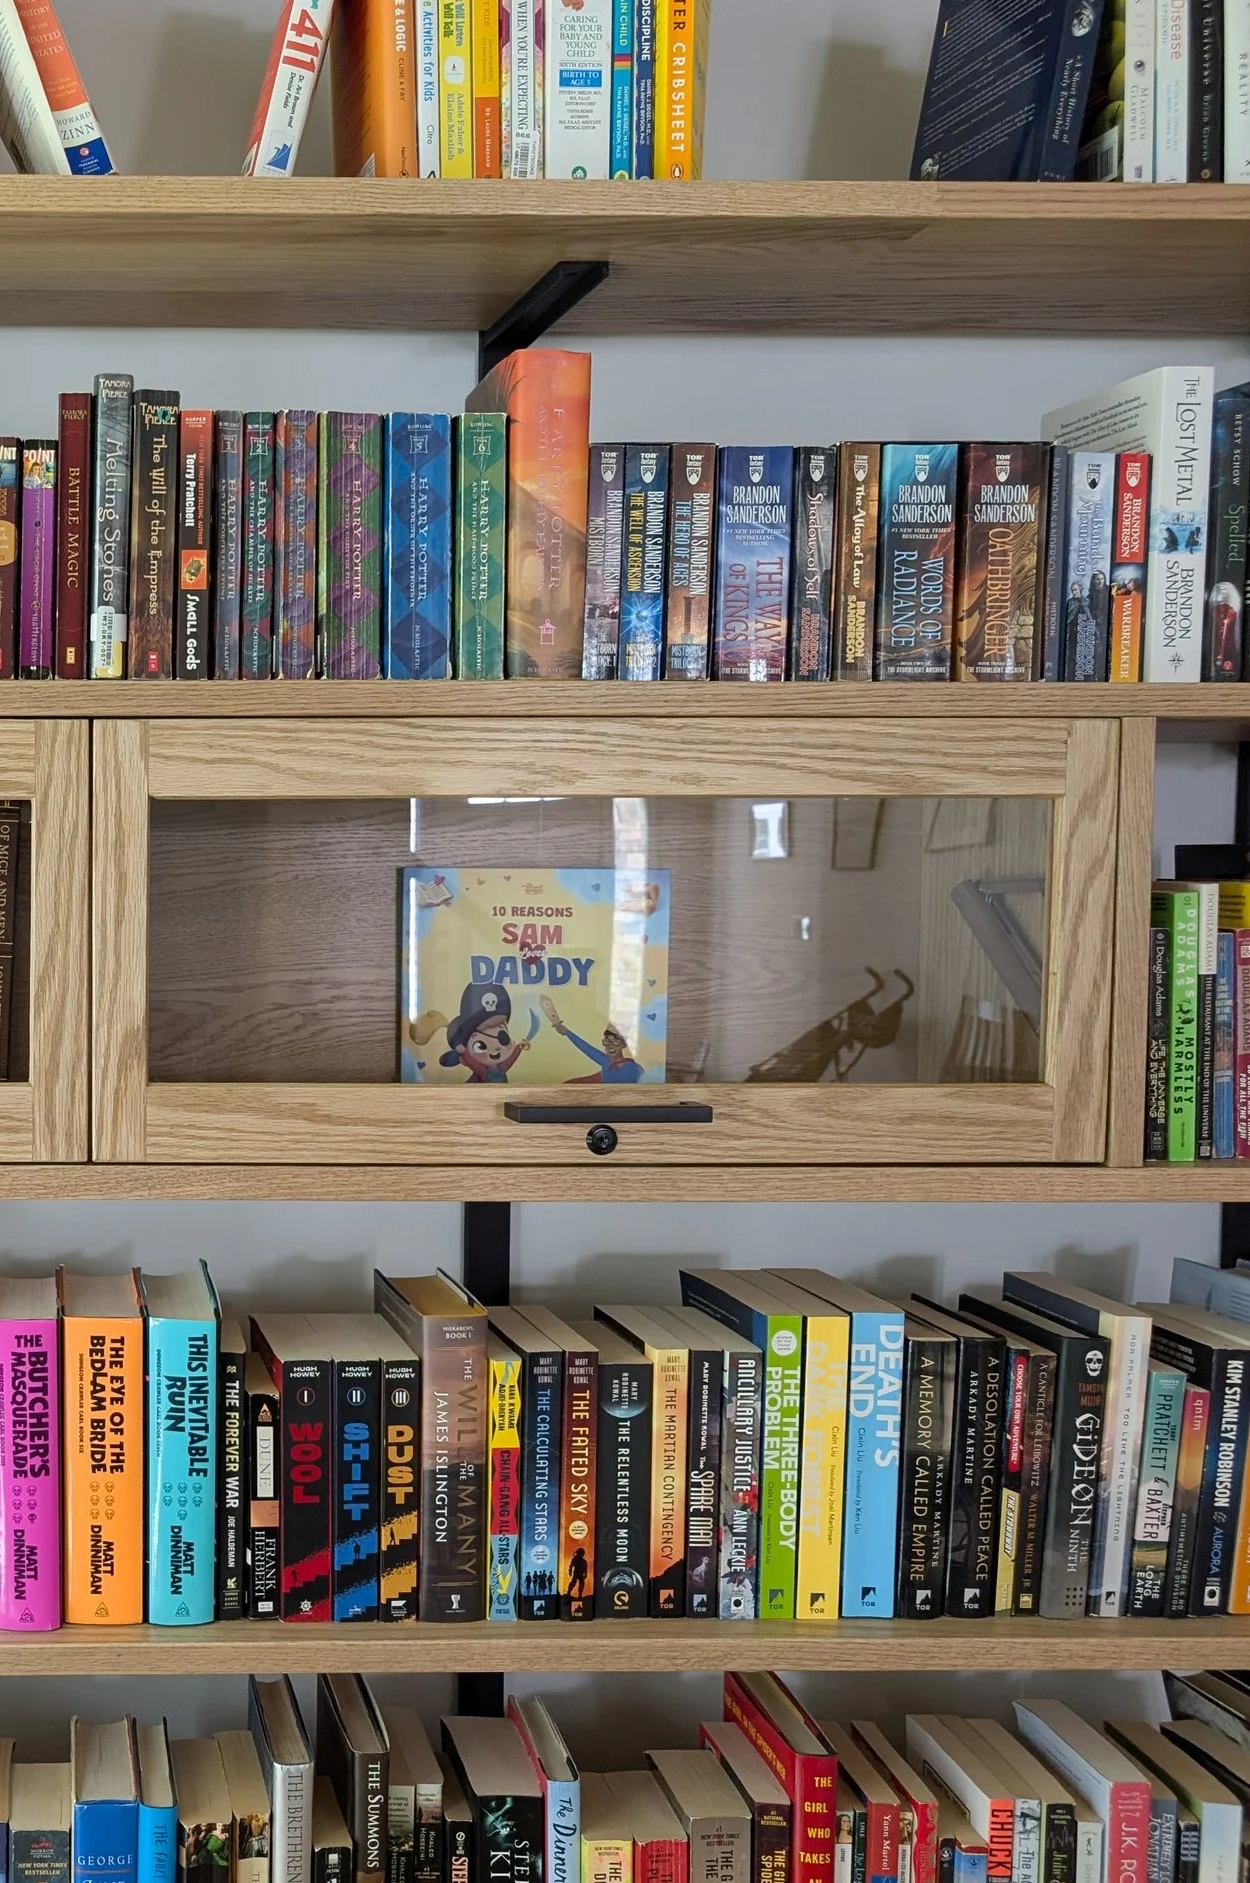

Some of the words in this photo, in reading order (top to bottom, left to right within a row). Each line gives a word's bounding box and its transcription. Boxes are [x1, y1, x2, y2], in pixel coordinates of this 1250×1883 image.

[564, 16, 598, 24] CARING
[282, 9, 324, 74] 411
[670, 43, 685, 152] CRIBSHEET
[56, 111, 91, 127] HOWARD
[62, 122, 95, 141] ZINN
[1183, 376, 1201, 398] THE
[1177, 402, 1201, 442] LOST
[153, 434, 167, 462] The
[98, 438, 123, 522] Melting
[154, 466, 165, 495] Will
[733, 485, 780, 503] BRANDON
[1176, 447, 1199, 506] METAL
[146, 500, 165, 518] of
[418, 476, 429, 538] HARRY
[726, 505, 786, 524] SANDERSON
[151, 522, 165, 545] the
[103, 525, 122, 603] Stones
[148, 551, 163, 616] Empress
[417, 544, 428, 601] POTTER
[729, 562, 745, 581] OF
[756, 557, 783, 597] THE
[725, 585, 749, 642] KINGS
[984, 528, 1014, 658] OATHBRINGER
[755, 601, 782, 644] WAY
[1121, 599, 1132, 679] WARBREAKER
[0, 825, 10, 842] OF
[492, 906, 506, 917] 10
[511, 906, 573, 918] REASONS
[502, 923, 562, 944] SAM
[521, 947, 546, 959] Loves
[470, 955, 595, 985] DADDY
[1174, 1027, 1184, 1114] HARMLESS
[1184, 1037, 1194, 1103] MOSTLY
[14, 1335, 43, 1347] THE
[187, 1334, 208, 1374] THIS
[922, 1356, 934, 1368] A
[1226, 1360, 1243, 1384] KIM
[164, 1375, 186, 1433] RUIN
[225, 1380, 239, 1406] THE
[784, 1366, 800, 1407] THE
[10, 1352, 28, 1479] MASQUERADE
[27, 1351, 50, 1478] BUTCHER'S
[187, 1375, 208, 1478] INEVITABLE
[764, 1366, 782, 1469] PROBLEM
[918, 1373, 934, 1450] MEMORY
[1221, 1386, 1241, 1439] STANLEY
[225, 1409, 240, 1473] FOREVER
[289, 1422, 323, 1504] WOOL
[343, 1423, 370, 1521] SHIFT
[388, 1424, 414, 1505] DUST
[778, 1414, 799, 1550] THREE-BODY
[1214, 1443, 1235, 1508] ROBINSON
[225, 1475, 239, 1508] WAR
[913, 1456, 929, 1518] CALLED
[910, 1523, 926, 1581] EMPIRE
[368, 1762, 380, 1789] THE
[814, 1777, 832, 1788] THE
[804, 1802, 828, 1814] GIRL
[367, 1795, 384, 1868] SUMMONS
[807, 1828, 830, 1839] WHO
[77, 1855, 133, 1866] GEORGE
[800, 1853, 831, 1864] TAKES
